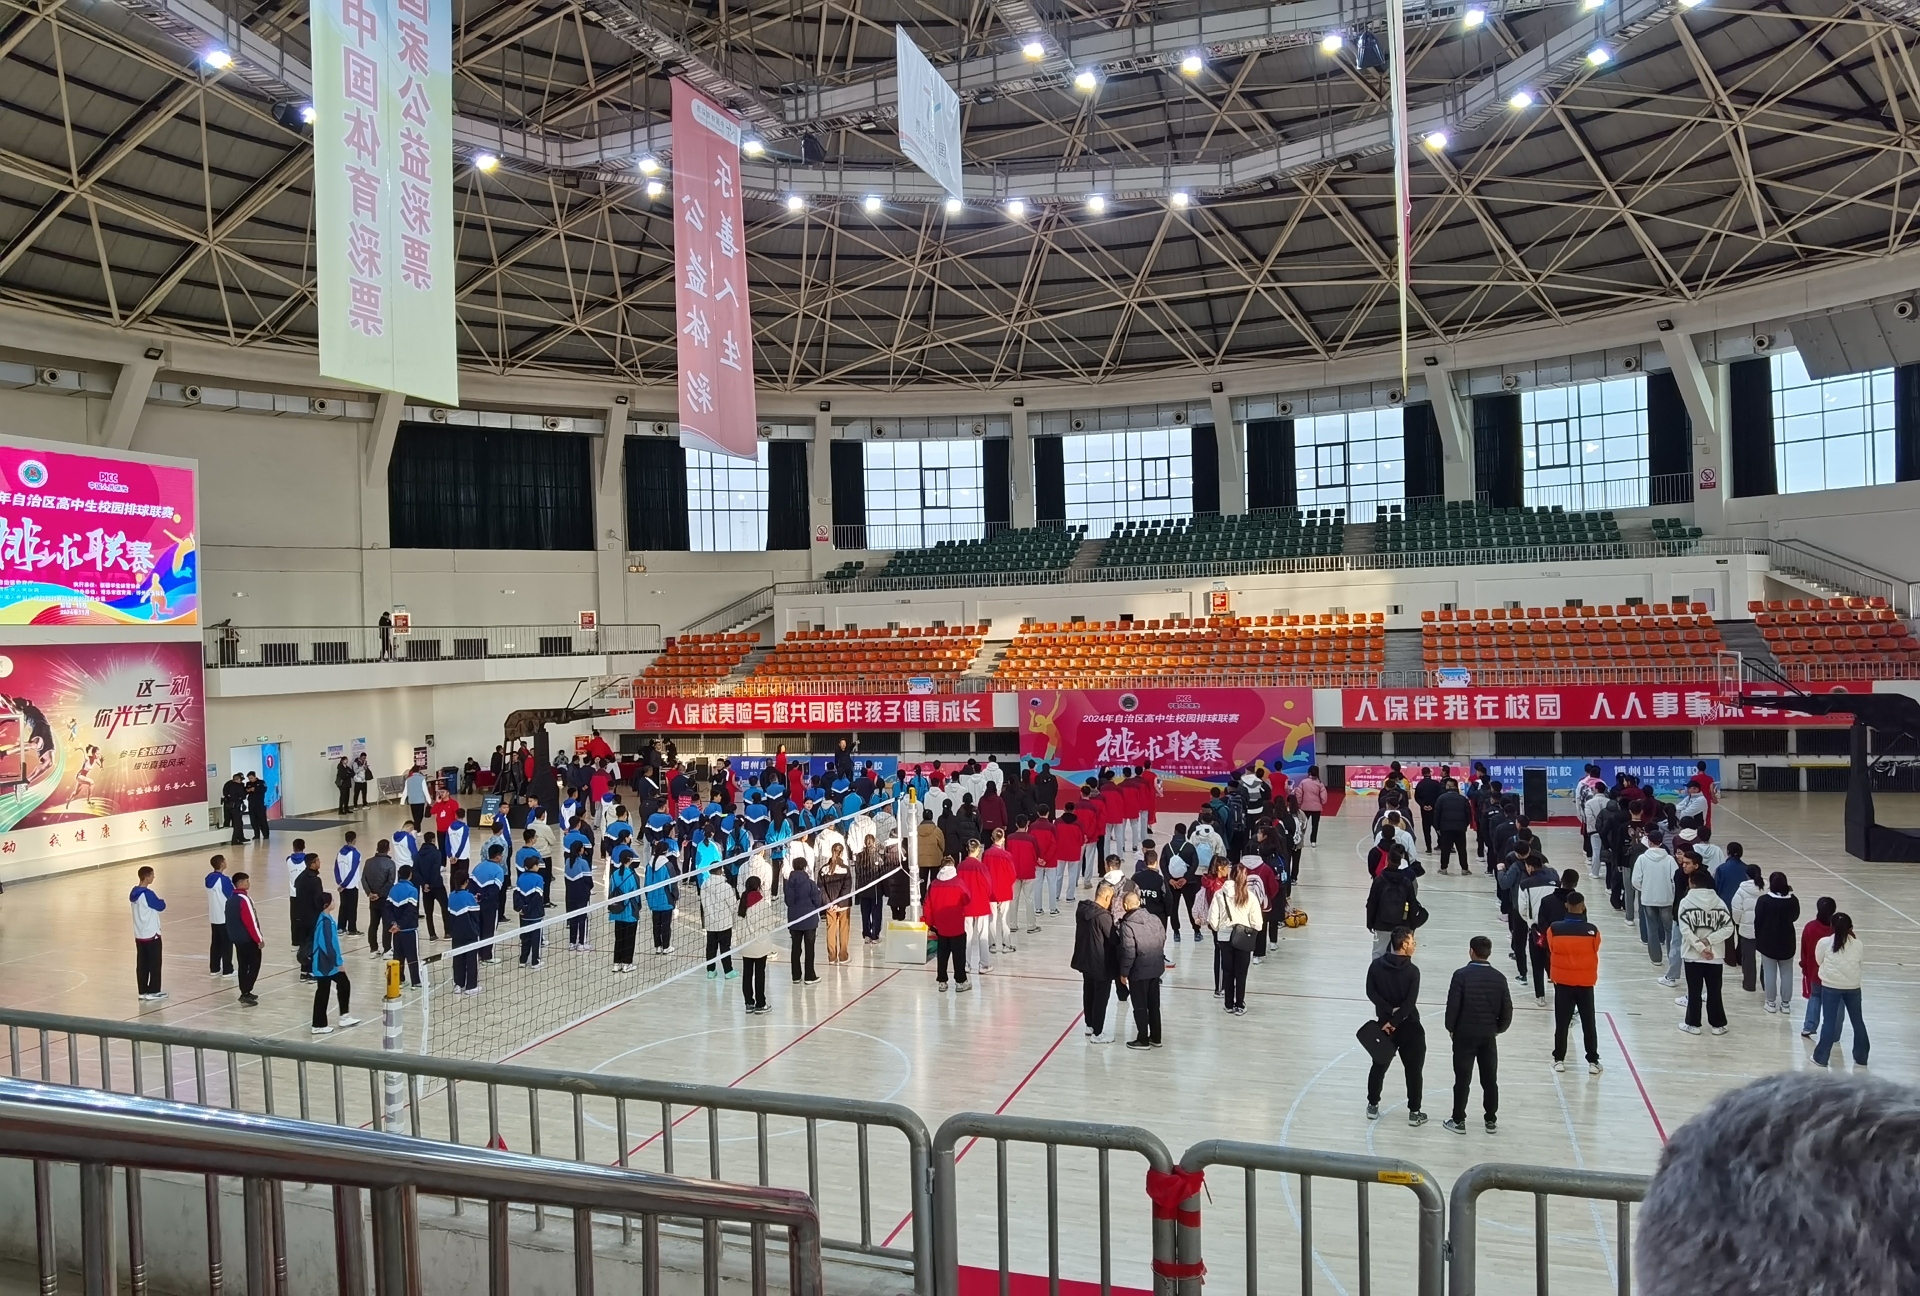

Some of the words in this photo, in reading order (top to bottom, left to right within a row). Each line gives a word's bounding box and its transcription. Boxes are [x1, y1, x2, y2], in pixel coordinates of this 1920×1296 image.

[94, 697, 194, 739] 你光芒万丈
[666, 699, 981, 725] 人保校责险与您共同陪伴孩子健康成长
[1082, 713, 1240, 723] 2024年自治区高中生校园排球联赛
[1354, 694, 1561, 721] 人保伴我在校园
[1096, 726, 1223, 763] 排球联赛
[164, 780, 196, 791] 乐善人生
[1140, 890, 1158, 898] YFS
